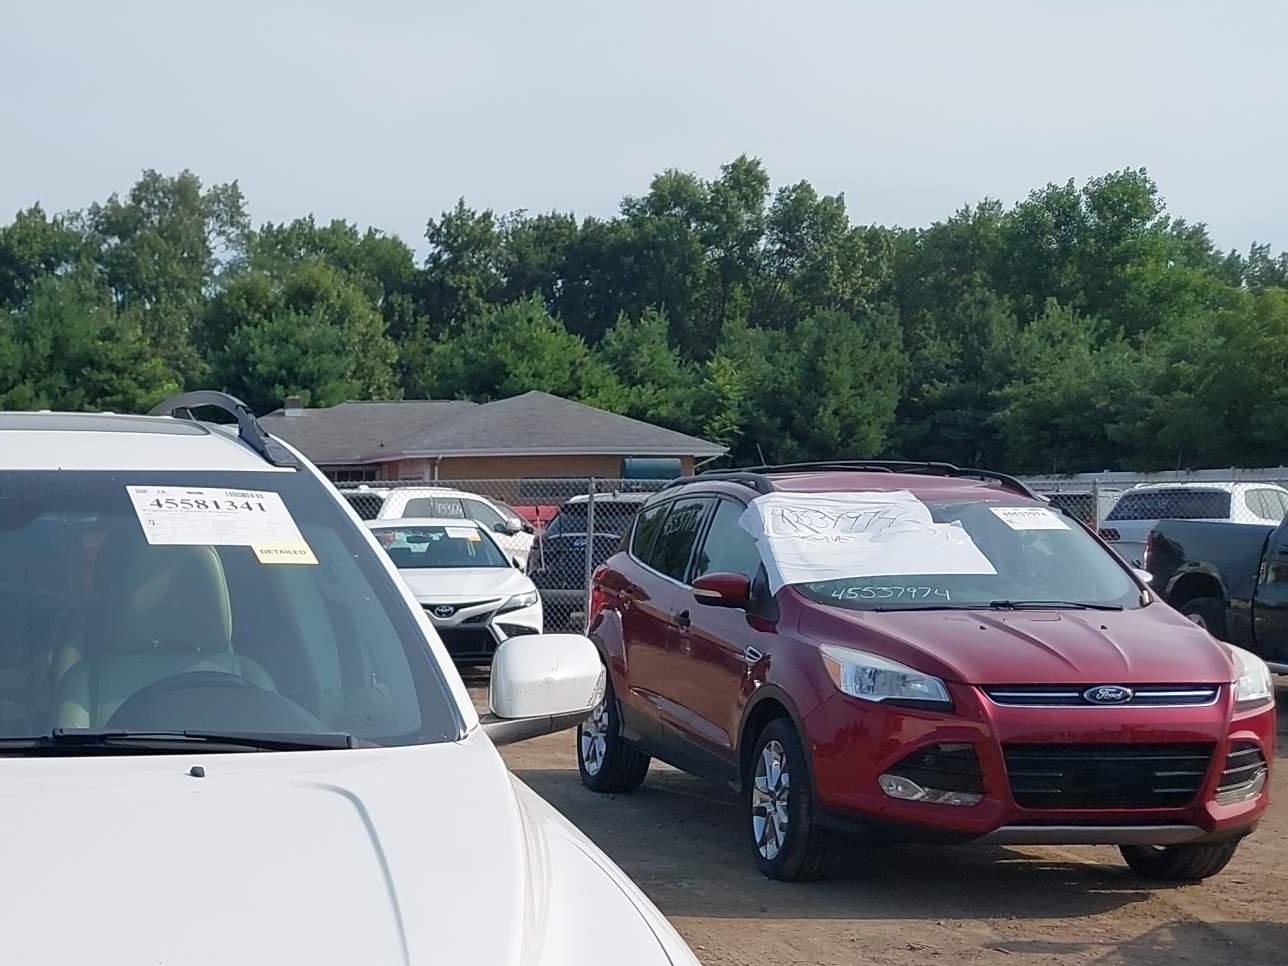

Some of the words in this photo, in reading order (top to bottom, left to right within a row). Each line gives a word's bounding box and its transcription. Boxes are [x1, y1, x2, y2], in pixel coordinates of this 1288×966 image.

[149, 498, 268, 513] 45581341
[831, 586, 951, 601] 45537974
[1095, 688, 1124, 700] Ford
